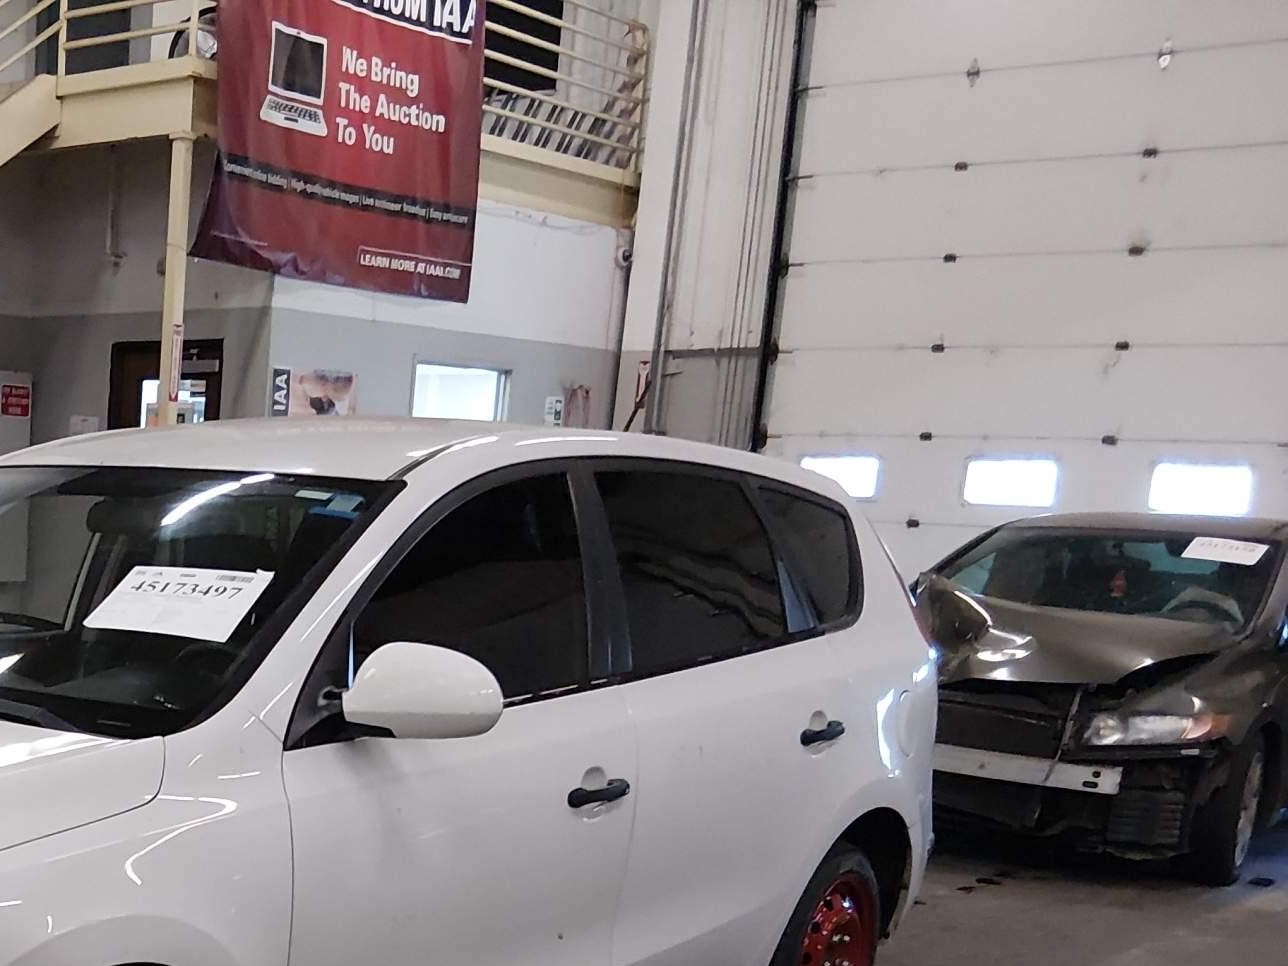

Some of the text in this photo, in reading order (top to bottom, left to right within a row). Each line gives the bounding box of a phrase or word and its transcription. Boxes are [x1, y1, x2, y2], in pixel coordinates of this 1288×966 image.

[341, 46, 420, 98] We Bring
[338, 82, 446, 133] The Auction
[335, 117, 395, 154] To You
[360, 254, 390, 269] LEARN
[390, 259, 416, 273] MORE
[273, 374, 288, 411] IAA
[130, 580, 244, 600] 45173497
